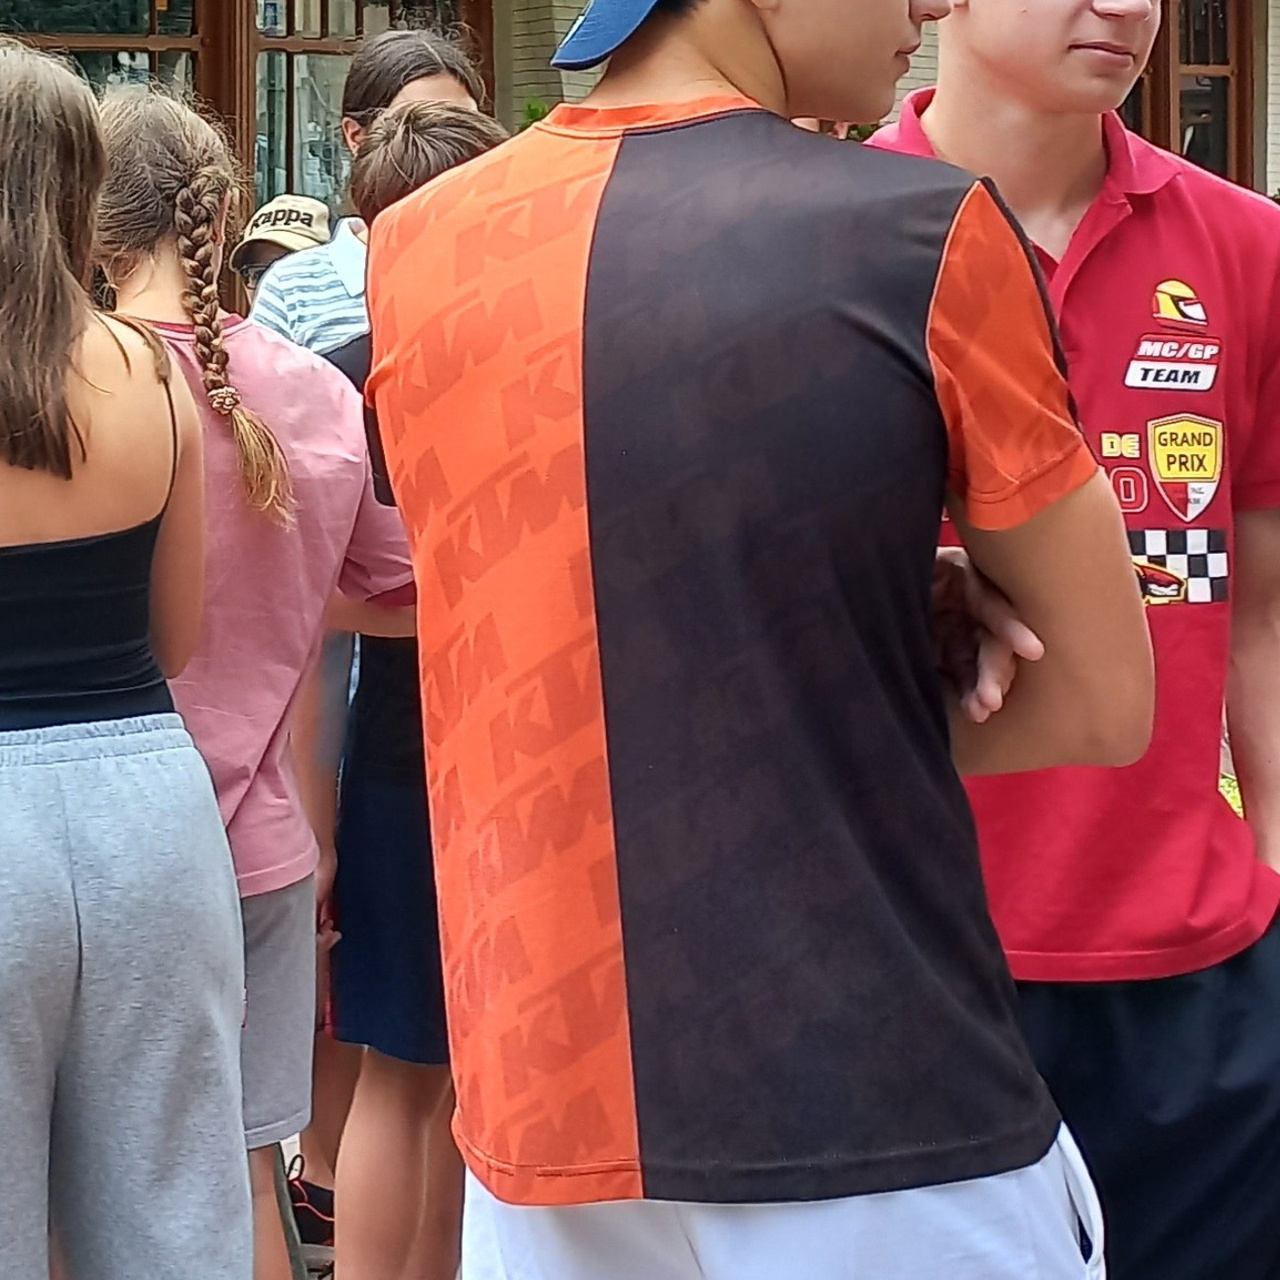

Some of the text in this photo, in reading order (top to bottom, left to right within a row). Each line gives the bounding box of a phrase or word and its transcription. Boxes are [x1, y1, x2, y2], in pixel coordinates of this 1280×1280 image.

[1137, 340, 1220, 360] MC/GP
[1140, 367, 1201, 384] TEAM
[1158, 431, 1214, 447] GRAND
[1166, 453, 1208, 472] PRIX
